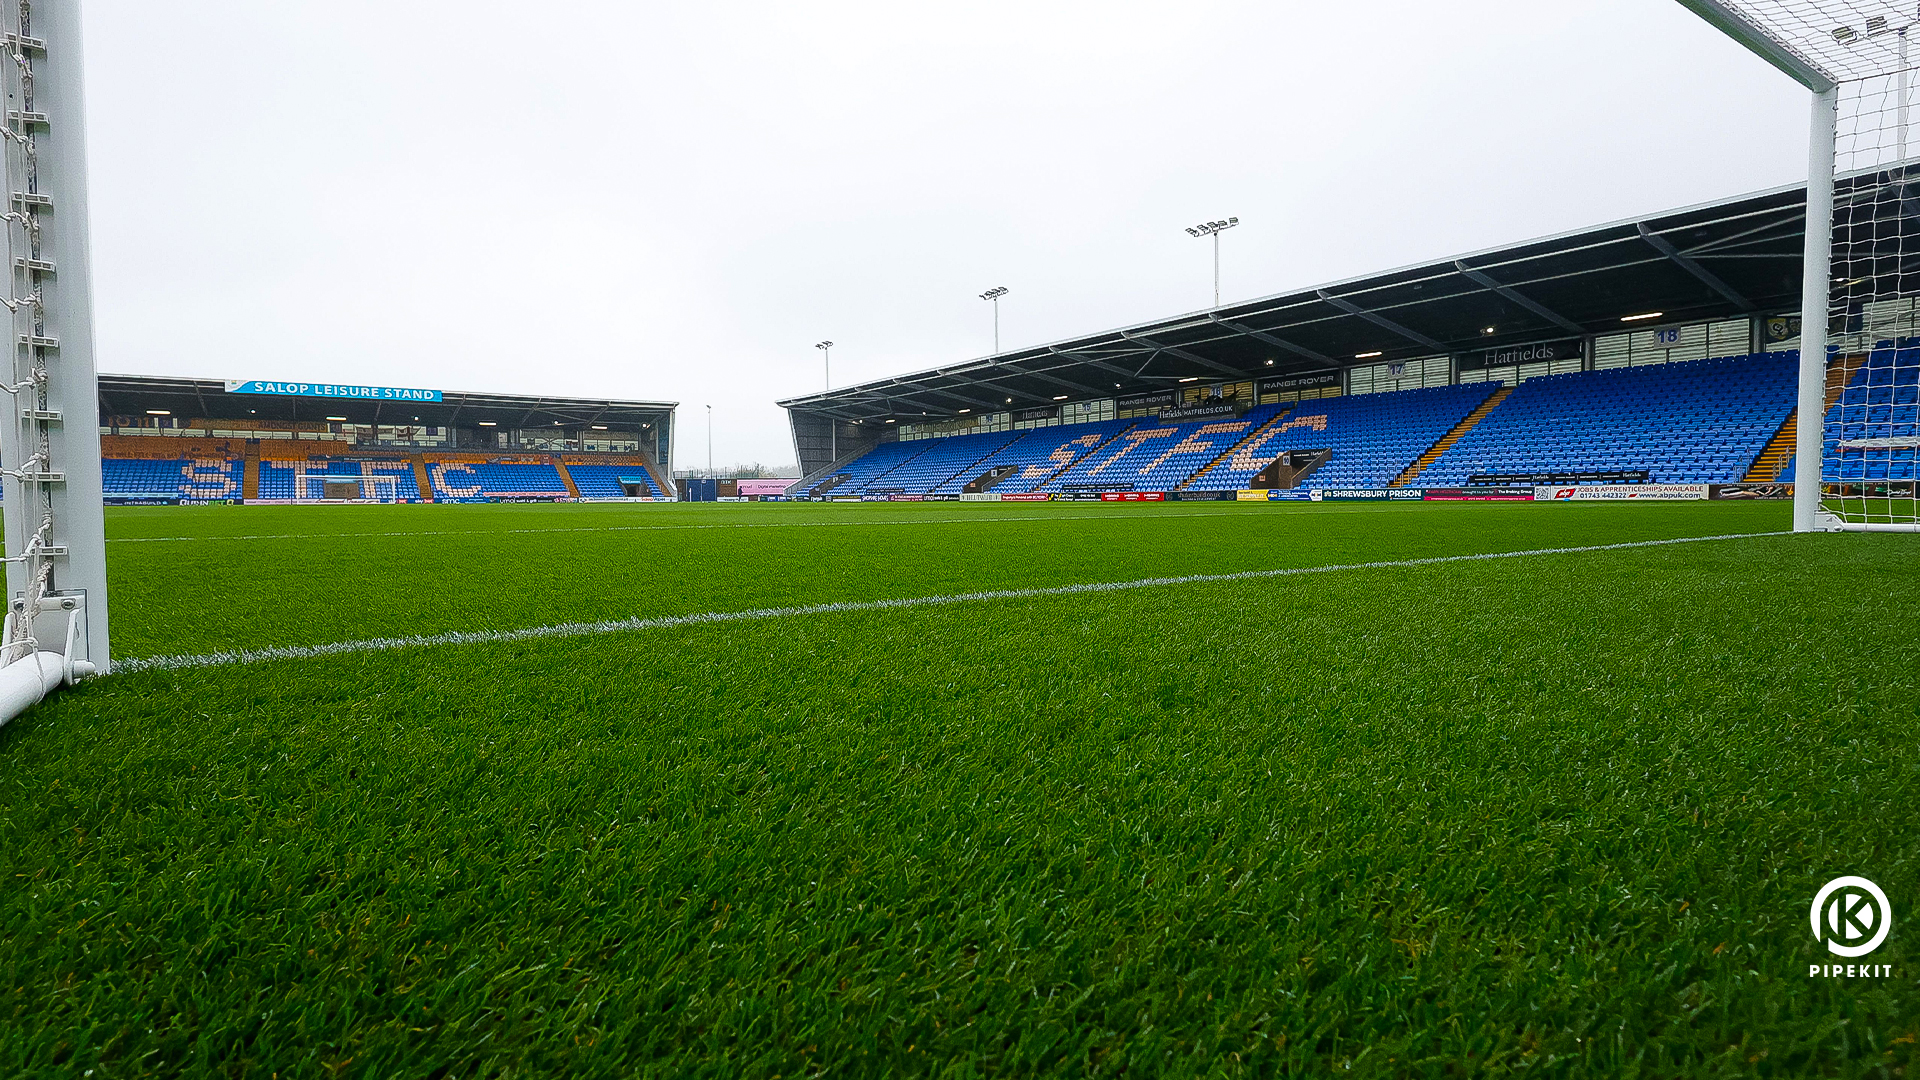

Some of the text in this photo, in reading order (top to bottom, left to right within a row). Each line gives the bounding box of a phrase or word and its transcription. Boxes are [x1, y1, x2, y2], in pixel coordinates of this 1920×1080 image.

[1657, 329, 1678, 343] 18
[1483, 343, 1554, 365] Hatfields
[1263, 375, 1335, 390] RANGE ROVER
[254, 382, 435, 400] SALOP LEISURE STAND
[1119, 395, 1172, 406] RANGE ROVER
[1332, 489, 1387, 497] SHREWSBURY
[1389, 489, 1422, 497] PRISON
